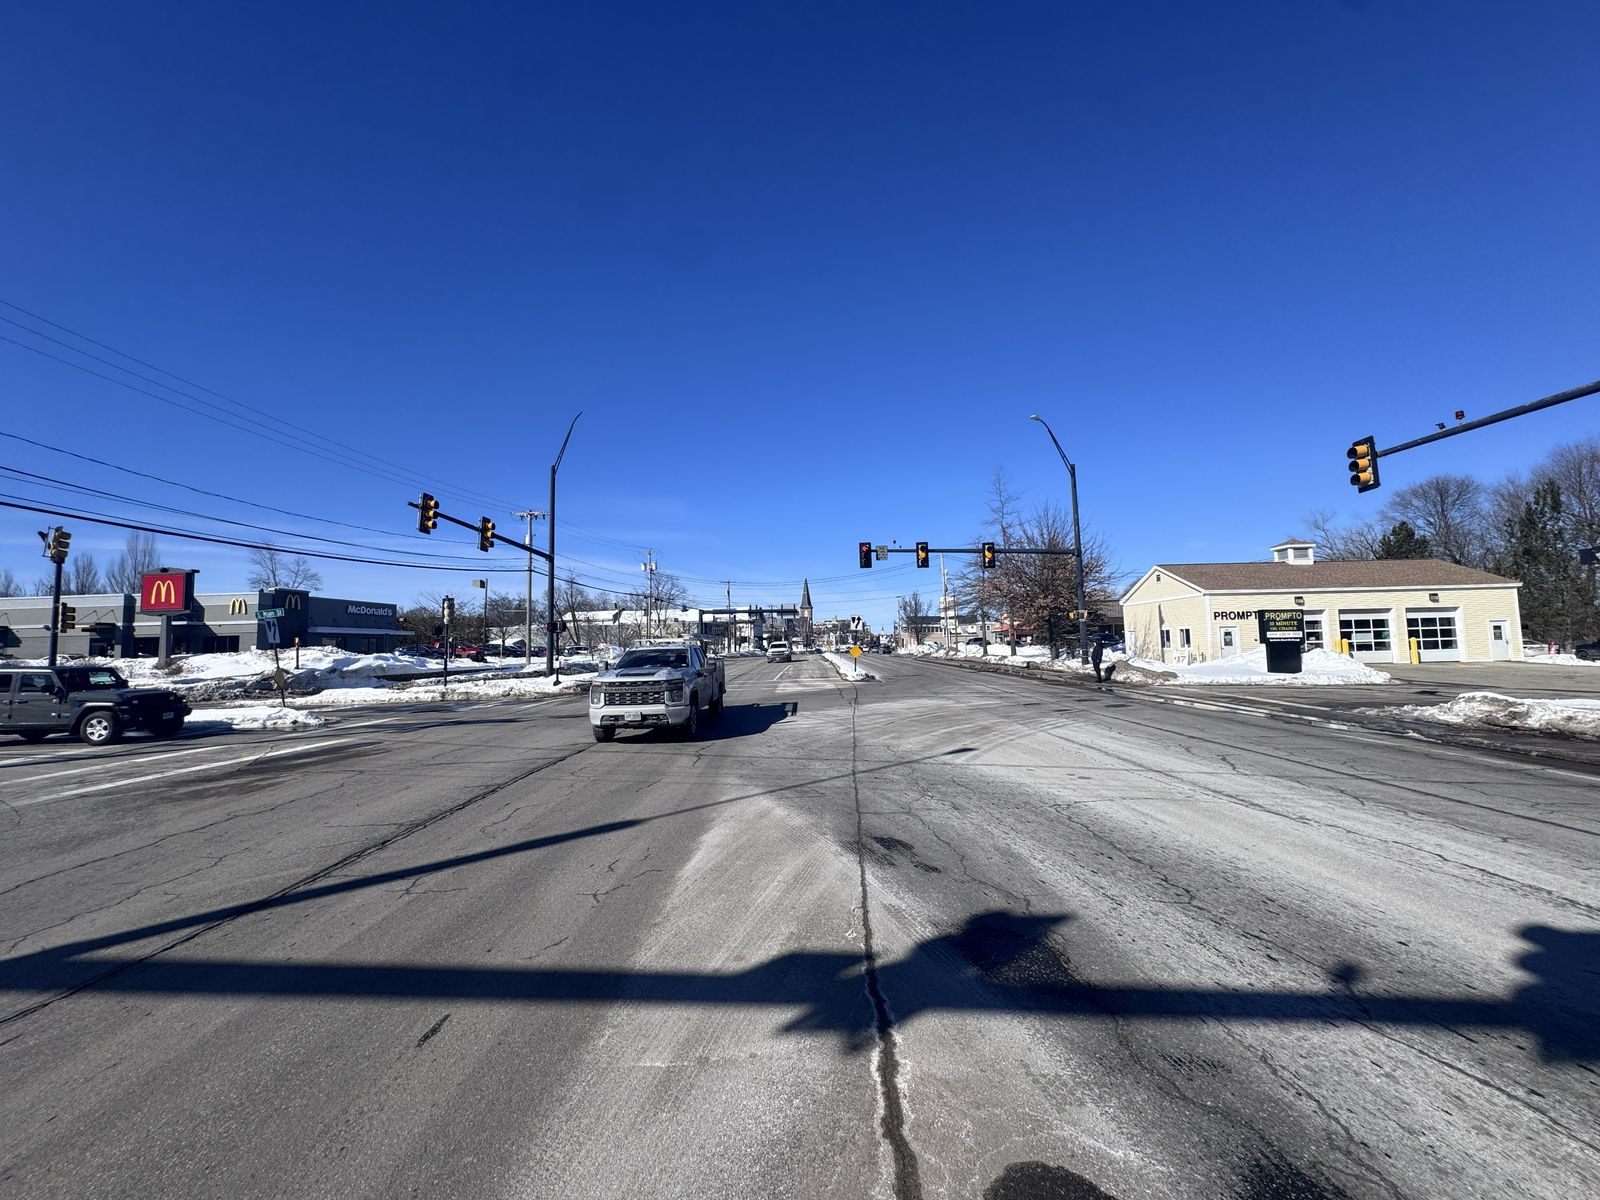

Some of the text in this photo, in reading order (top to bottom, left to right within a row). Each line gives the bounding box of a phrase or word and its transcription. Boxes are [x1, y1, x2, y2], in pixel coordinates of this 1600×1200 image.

[348, 605, 393, 616] McDonald's
[1214, 611, 1259, 620] PROMPT
[1265, 612, 1302, 620] PROMPTO
